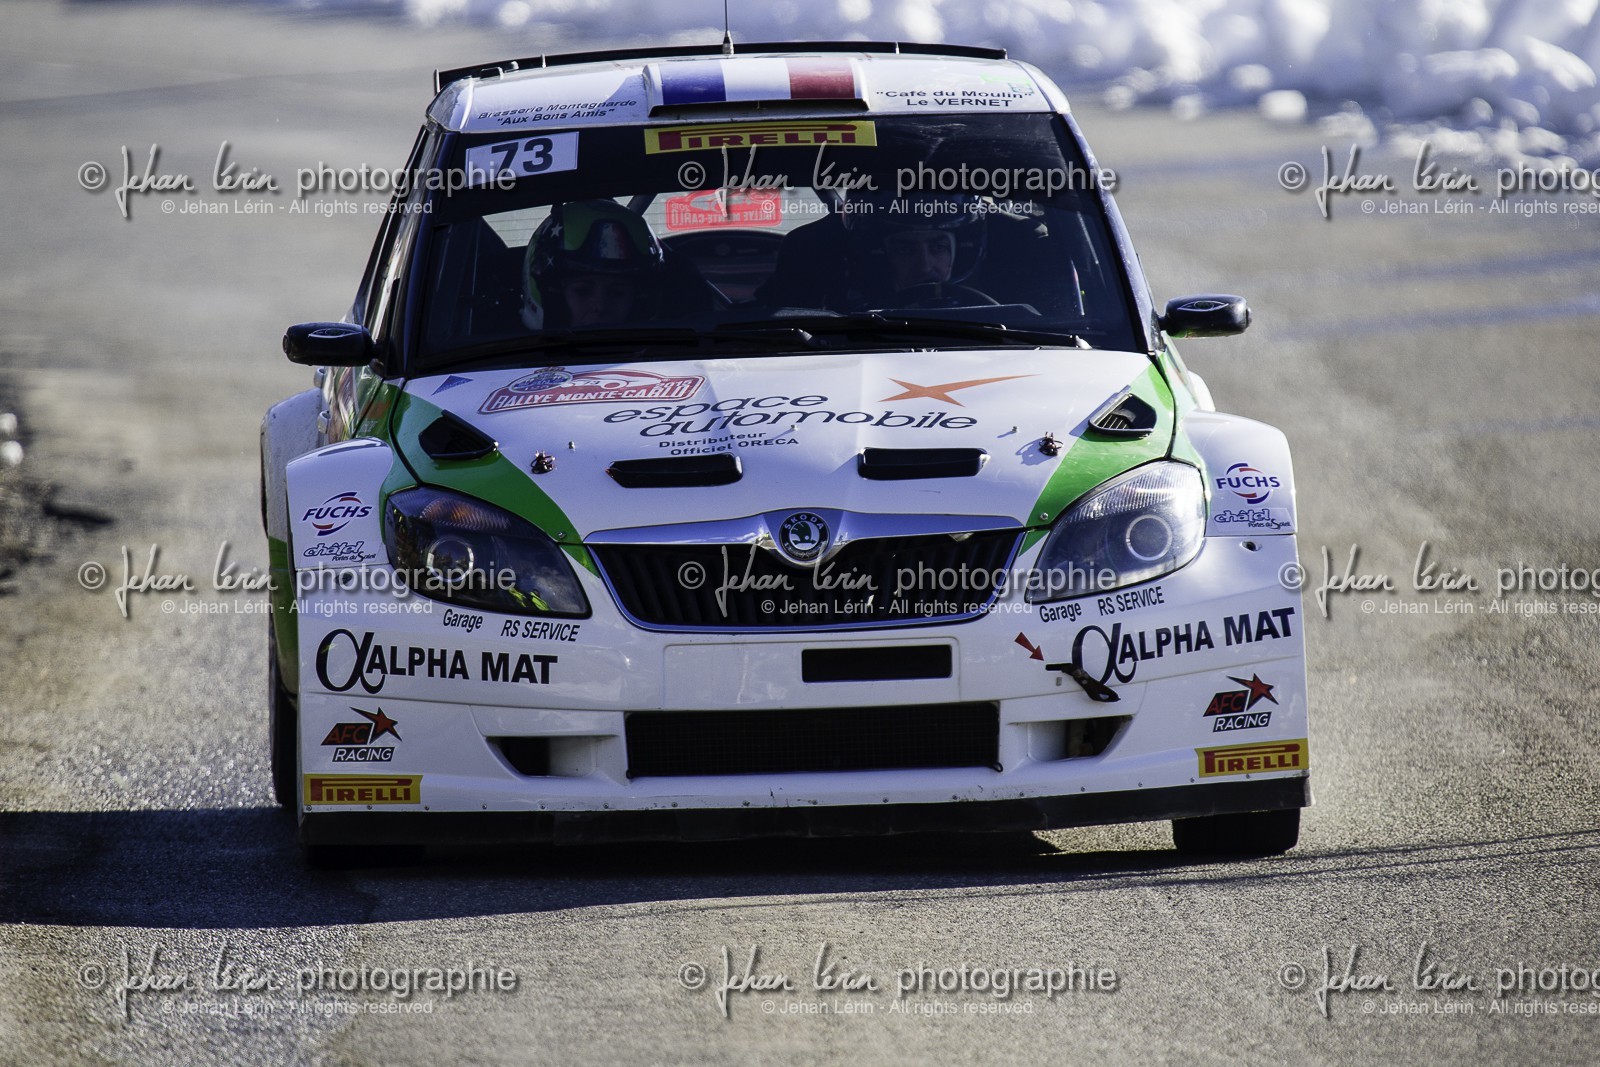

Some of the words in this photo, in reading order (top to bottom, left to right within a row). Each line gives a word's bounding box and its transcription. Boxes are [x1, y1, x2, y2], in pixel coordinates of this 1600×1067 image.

[876, 90, 927, 98] "Café
[933, 90, 955, 98] du
[962, 90, 1034, 99] Moulin"
[907, 98, 928, 106] Le
[934, 98, 1012, 107] VERNET
[478, 106, 543, 119] Brasserie
[548, 100, 637, 112] Montagnarde
[497, 116, 528, 126] "Aux
[532, 113, 568, 122] Bons
[572, 108, 615, 118] Amis"
[658, 124, 857, 150] PIRELLI
[491, 138, 553, 178] 73
[490, 394, 554, 410] RALLYE
[556, 384, 690, 402] MONTE-CARLO
[603, 395, 829, 424] espace
[640, 410, 978, 437] automobile
[659, 432, 767, 448] Distributeur
[670, 444, 732, 456] Officiel
[738, 438, 799, 448] ORECA
[1216, 476, 1280, 489] FUCHS
[302, 506, 372, 522] FUCHS
[1214, 508, 1270, 522] châtel
[304, 541, 364, 557] châtel
[1040, 602, 1082, 623] Garage
[1098, 597, 1115, 617] RS
[1116, 586, 1164, 612] SERVICE
[442, 608, 483, 633] Garage
[501, 619, 519, 638] RS
[521, 621, 580, 642] SERVICE
[1223, 607, 1296, 646] MAT
[481, 652, 558, 684] MAT
[1207, 692, 1245, 714] AFC
[1215, 714, 1268, 731] RACING
[326, 725, 369, 744] AFC
[334, 748, 392, 761] RACING
[1203, 744, 1300, 774] PIRELLI
[310, 778, 412, 801] PIRELLI
